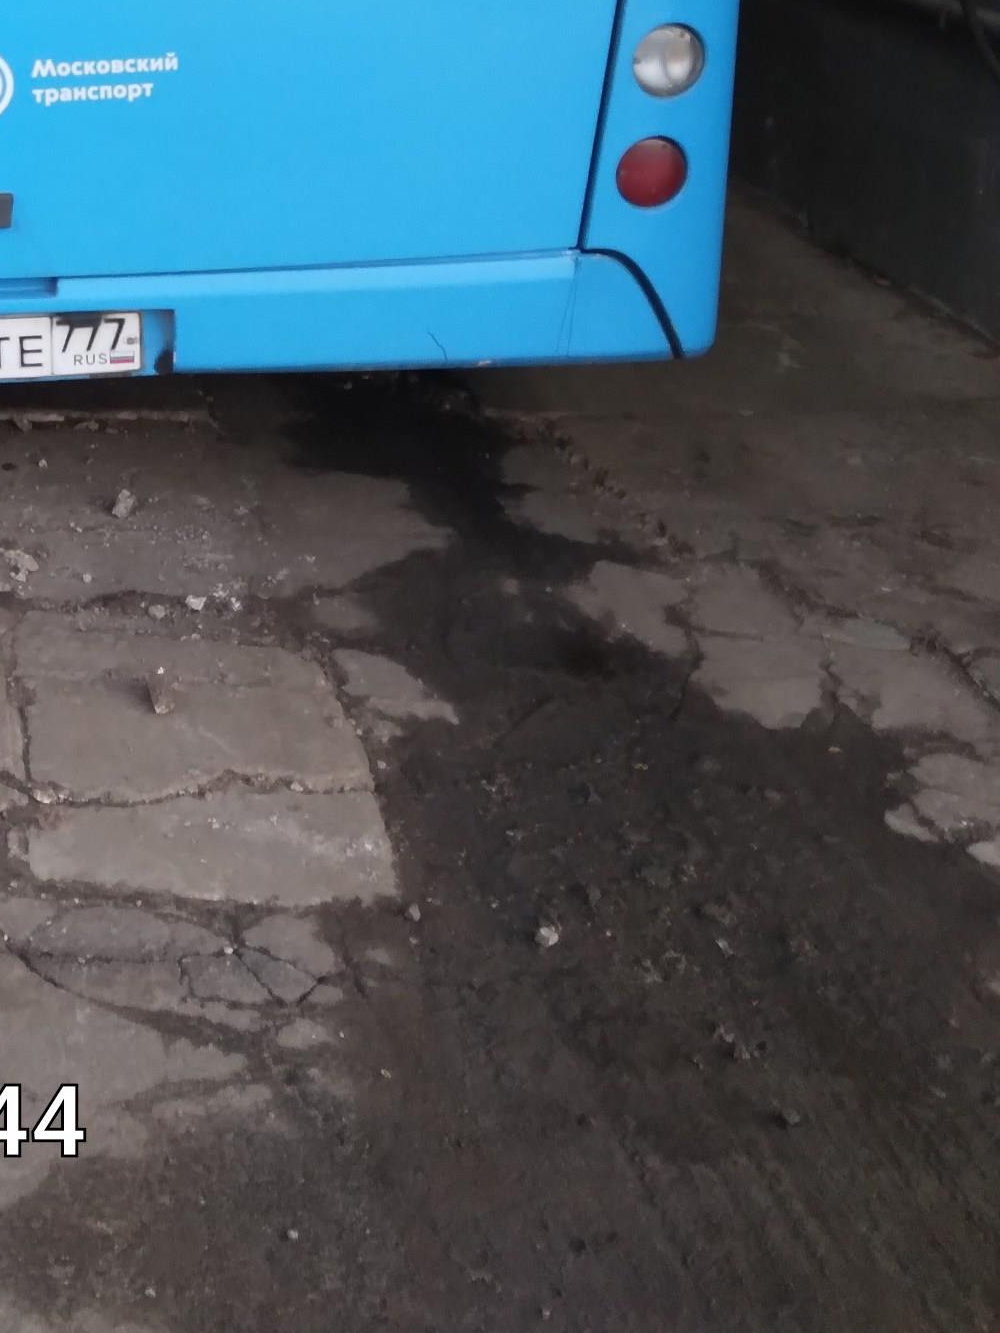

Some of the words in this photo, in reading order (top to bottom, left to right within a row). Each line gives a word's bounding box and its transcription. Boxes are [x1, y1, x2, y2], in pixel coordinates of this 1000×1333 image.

[31, 52, 179, 78] Московский
[31, 82, 154, 107] транспорт
[55, 317, 126, 353] 777
[73, 353, 108, 365] RUS
